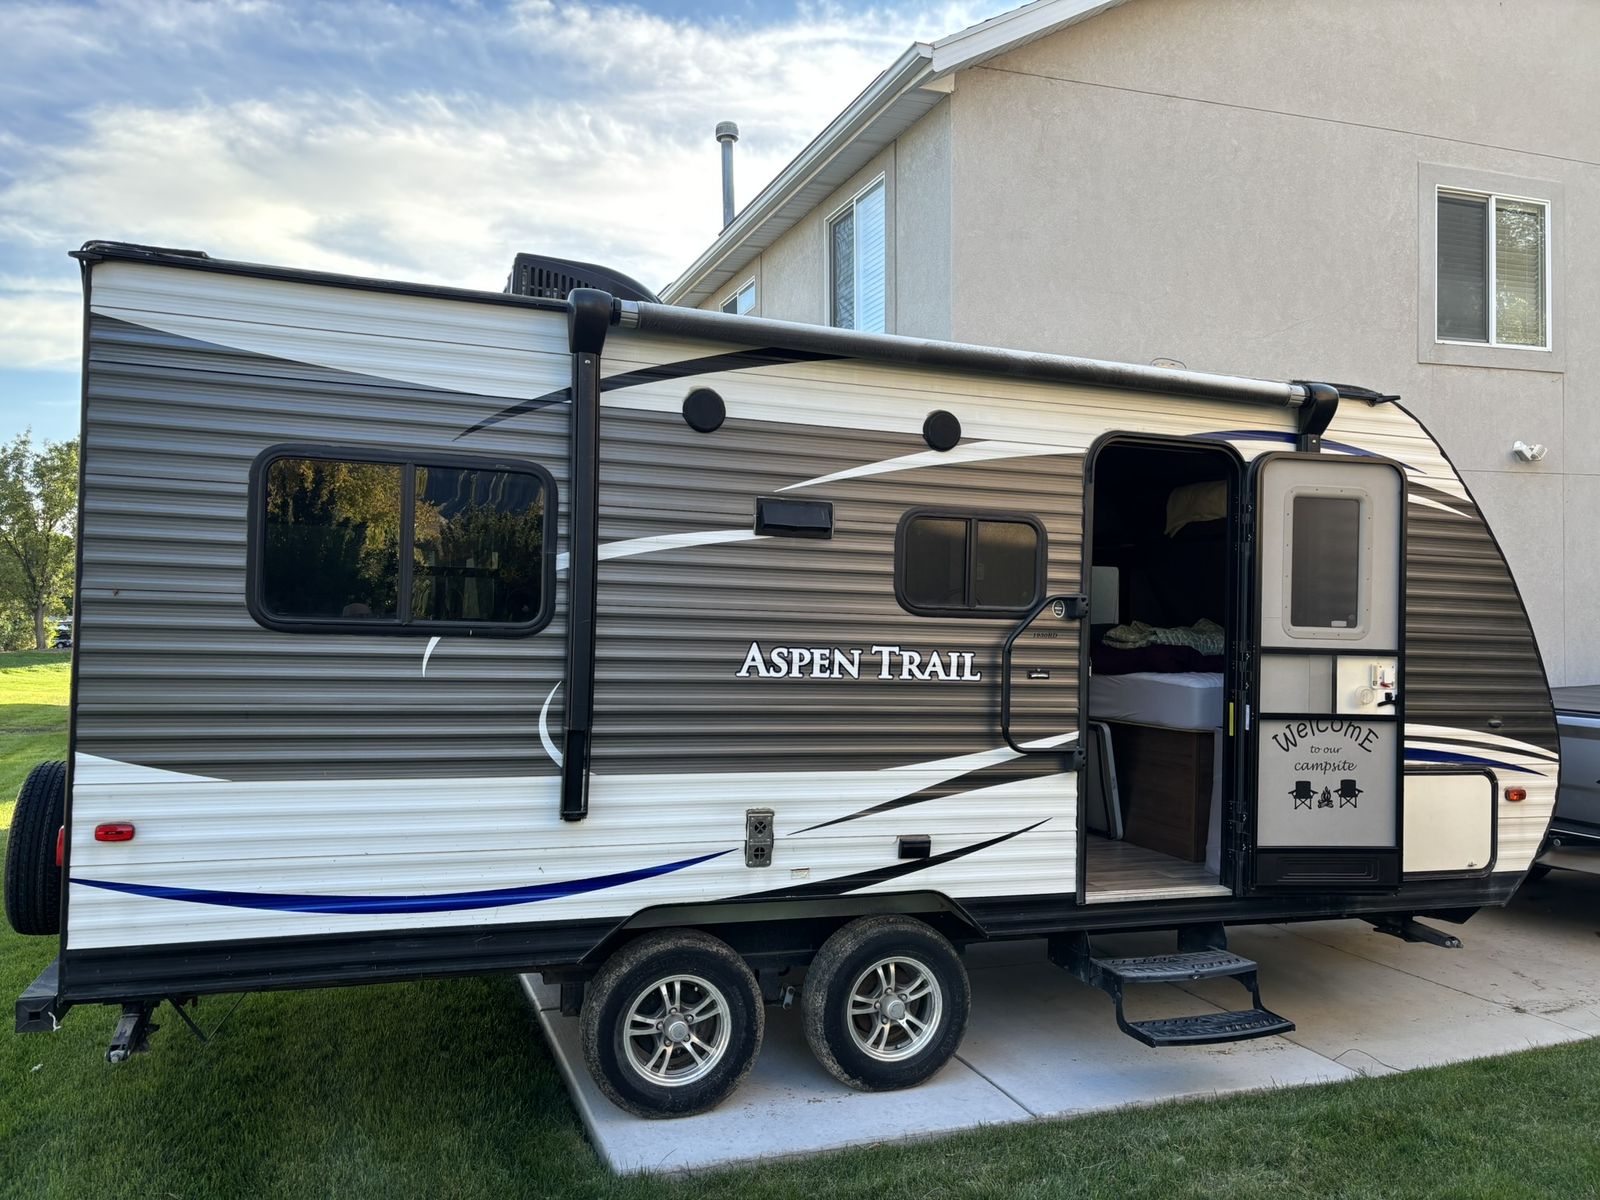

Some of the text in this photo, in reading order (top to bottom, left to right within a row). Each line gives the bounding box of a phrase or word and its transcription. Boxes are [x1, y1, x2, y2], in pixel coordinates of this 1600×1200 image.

[736, 641, 982, 681] ASPEN TRAIL
[1310, 745, 1342, 754] to our
[1294, 759, 1357, 775] campsite
